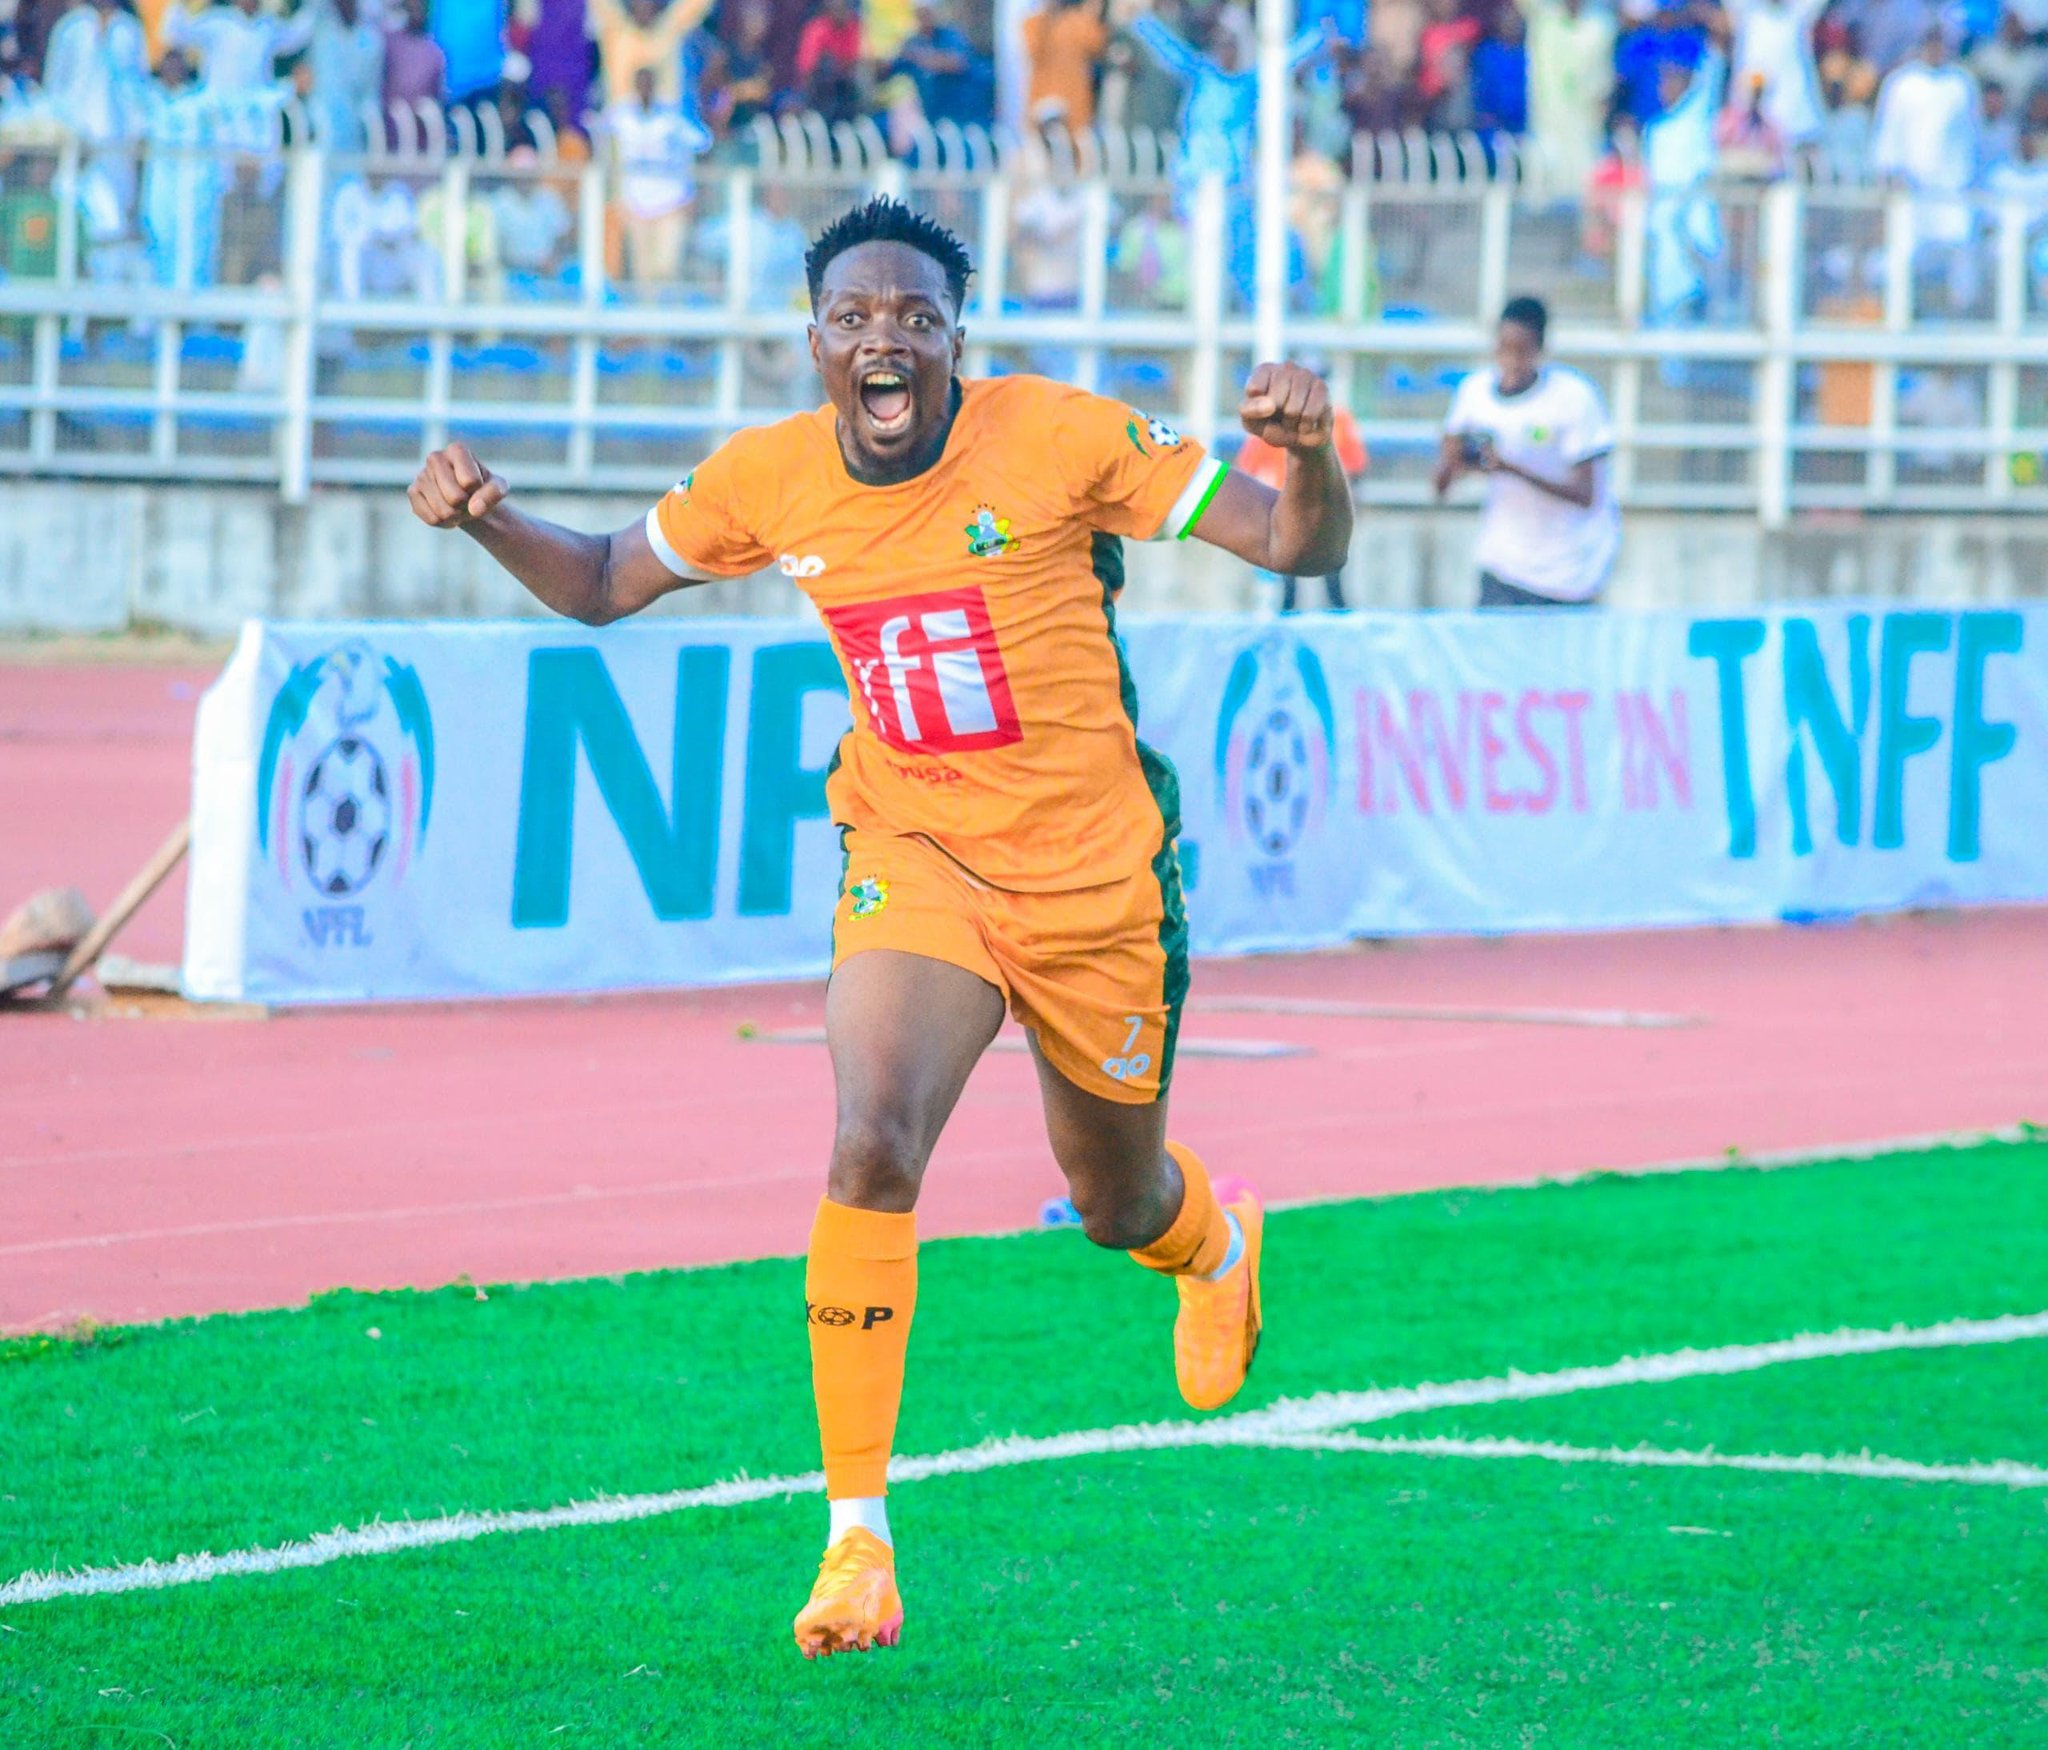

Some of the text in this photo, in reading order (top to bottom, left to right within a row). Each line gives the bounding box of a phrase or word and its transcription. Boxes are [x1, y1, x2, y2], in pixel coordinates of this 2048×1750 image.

[1358, 689, 1591, 814] INVEST
[1616, 689, 1689, 812] IN
[1123, 1016, 1143, 1053] 7
